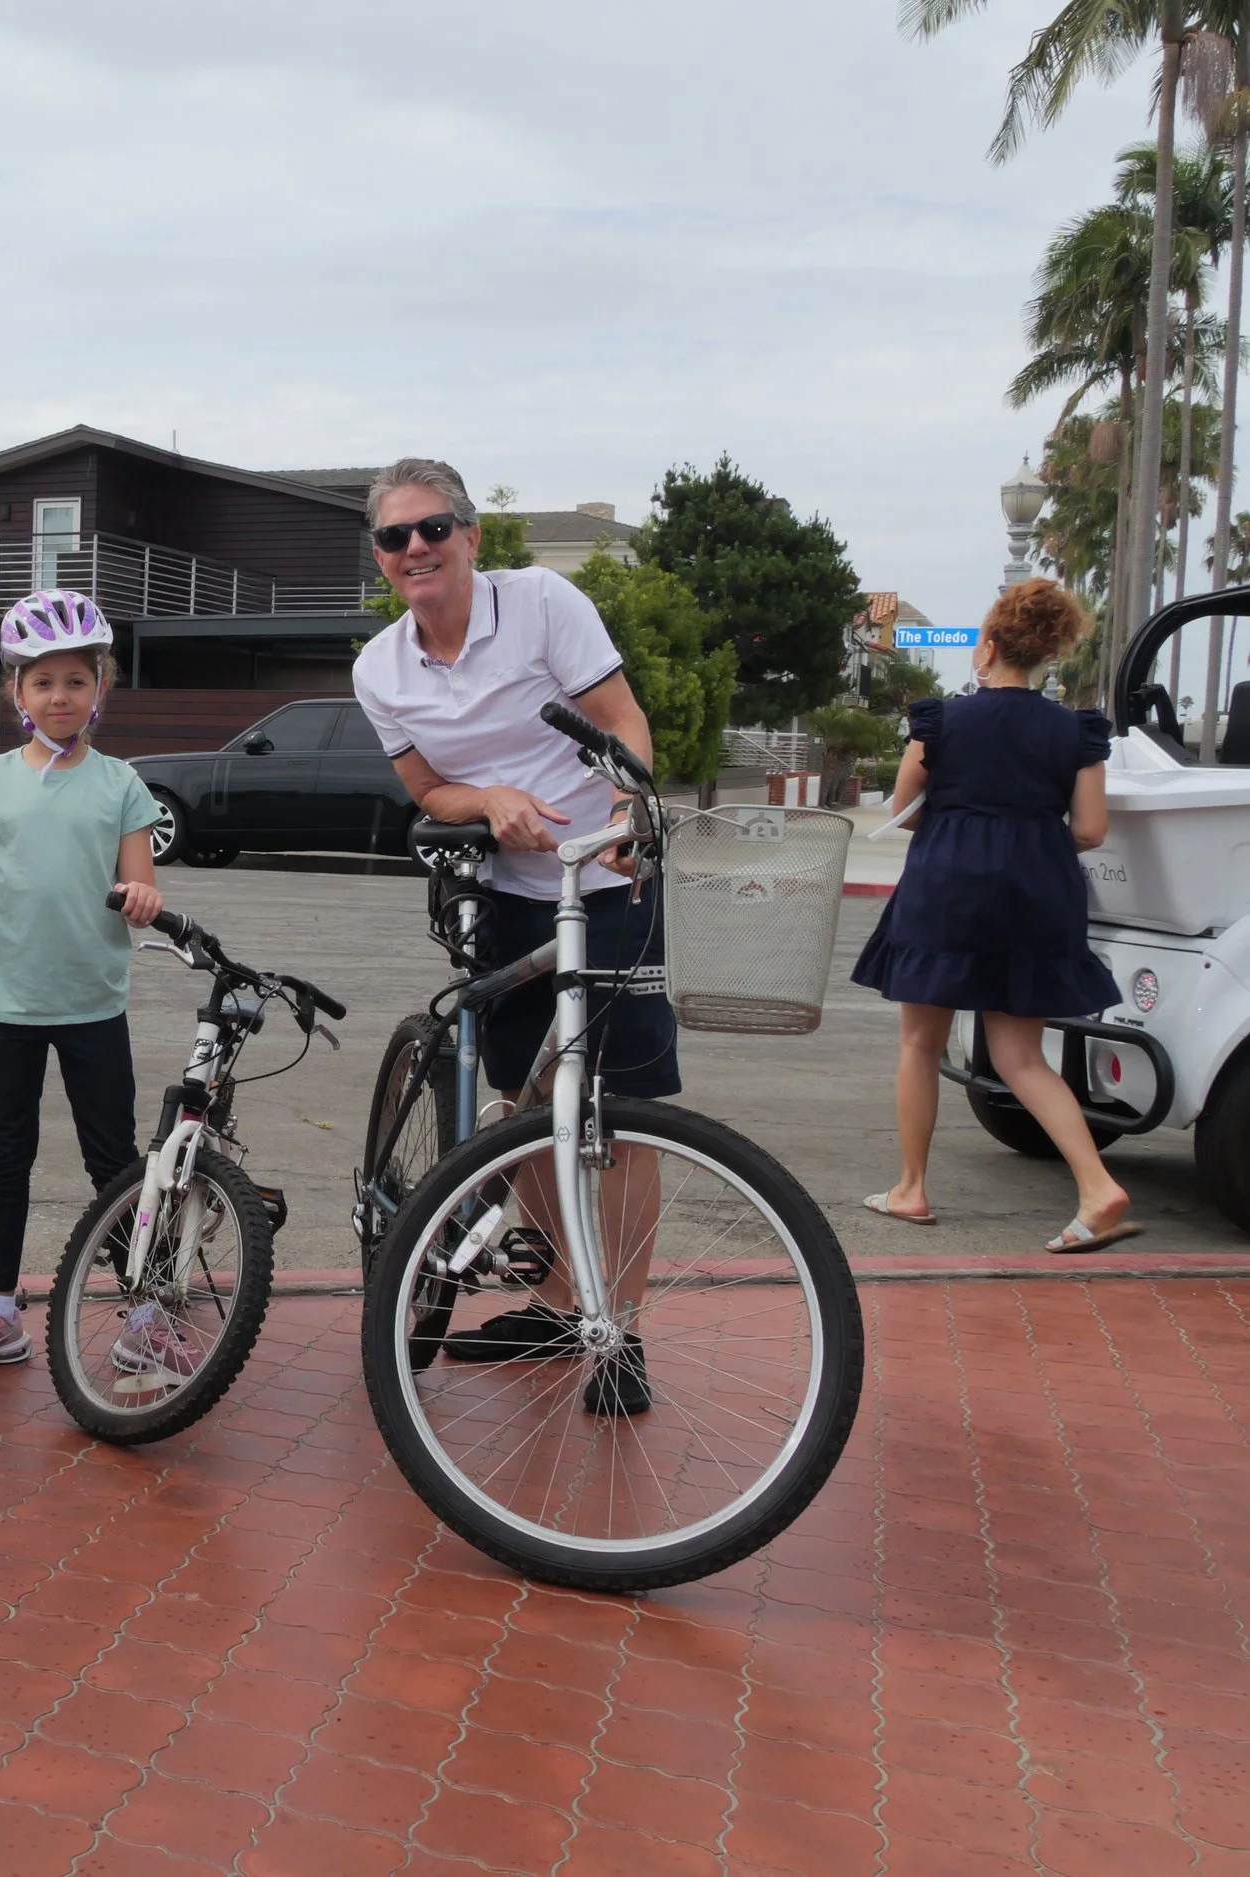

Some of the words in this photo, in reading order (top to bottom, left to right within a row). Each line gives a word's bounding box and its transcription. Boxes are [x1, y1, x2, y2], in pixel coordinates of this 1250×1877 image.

[899, 631, 921, 643] The
[926, 631, 968, 643] Toledo
[1099, 862, 1127, 882] 2nd
